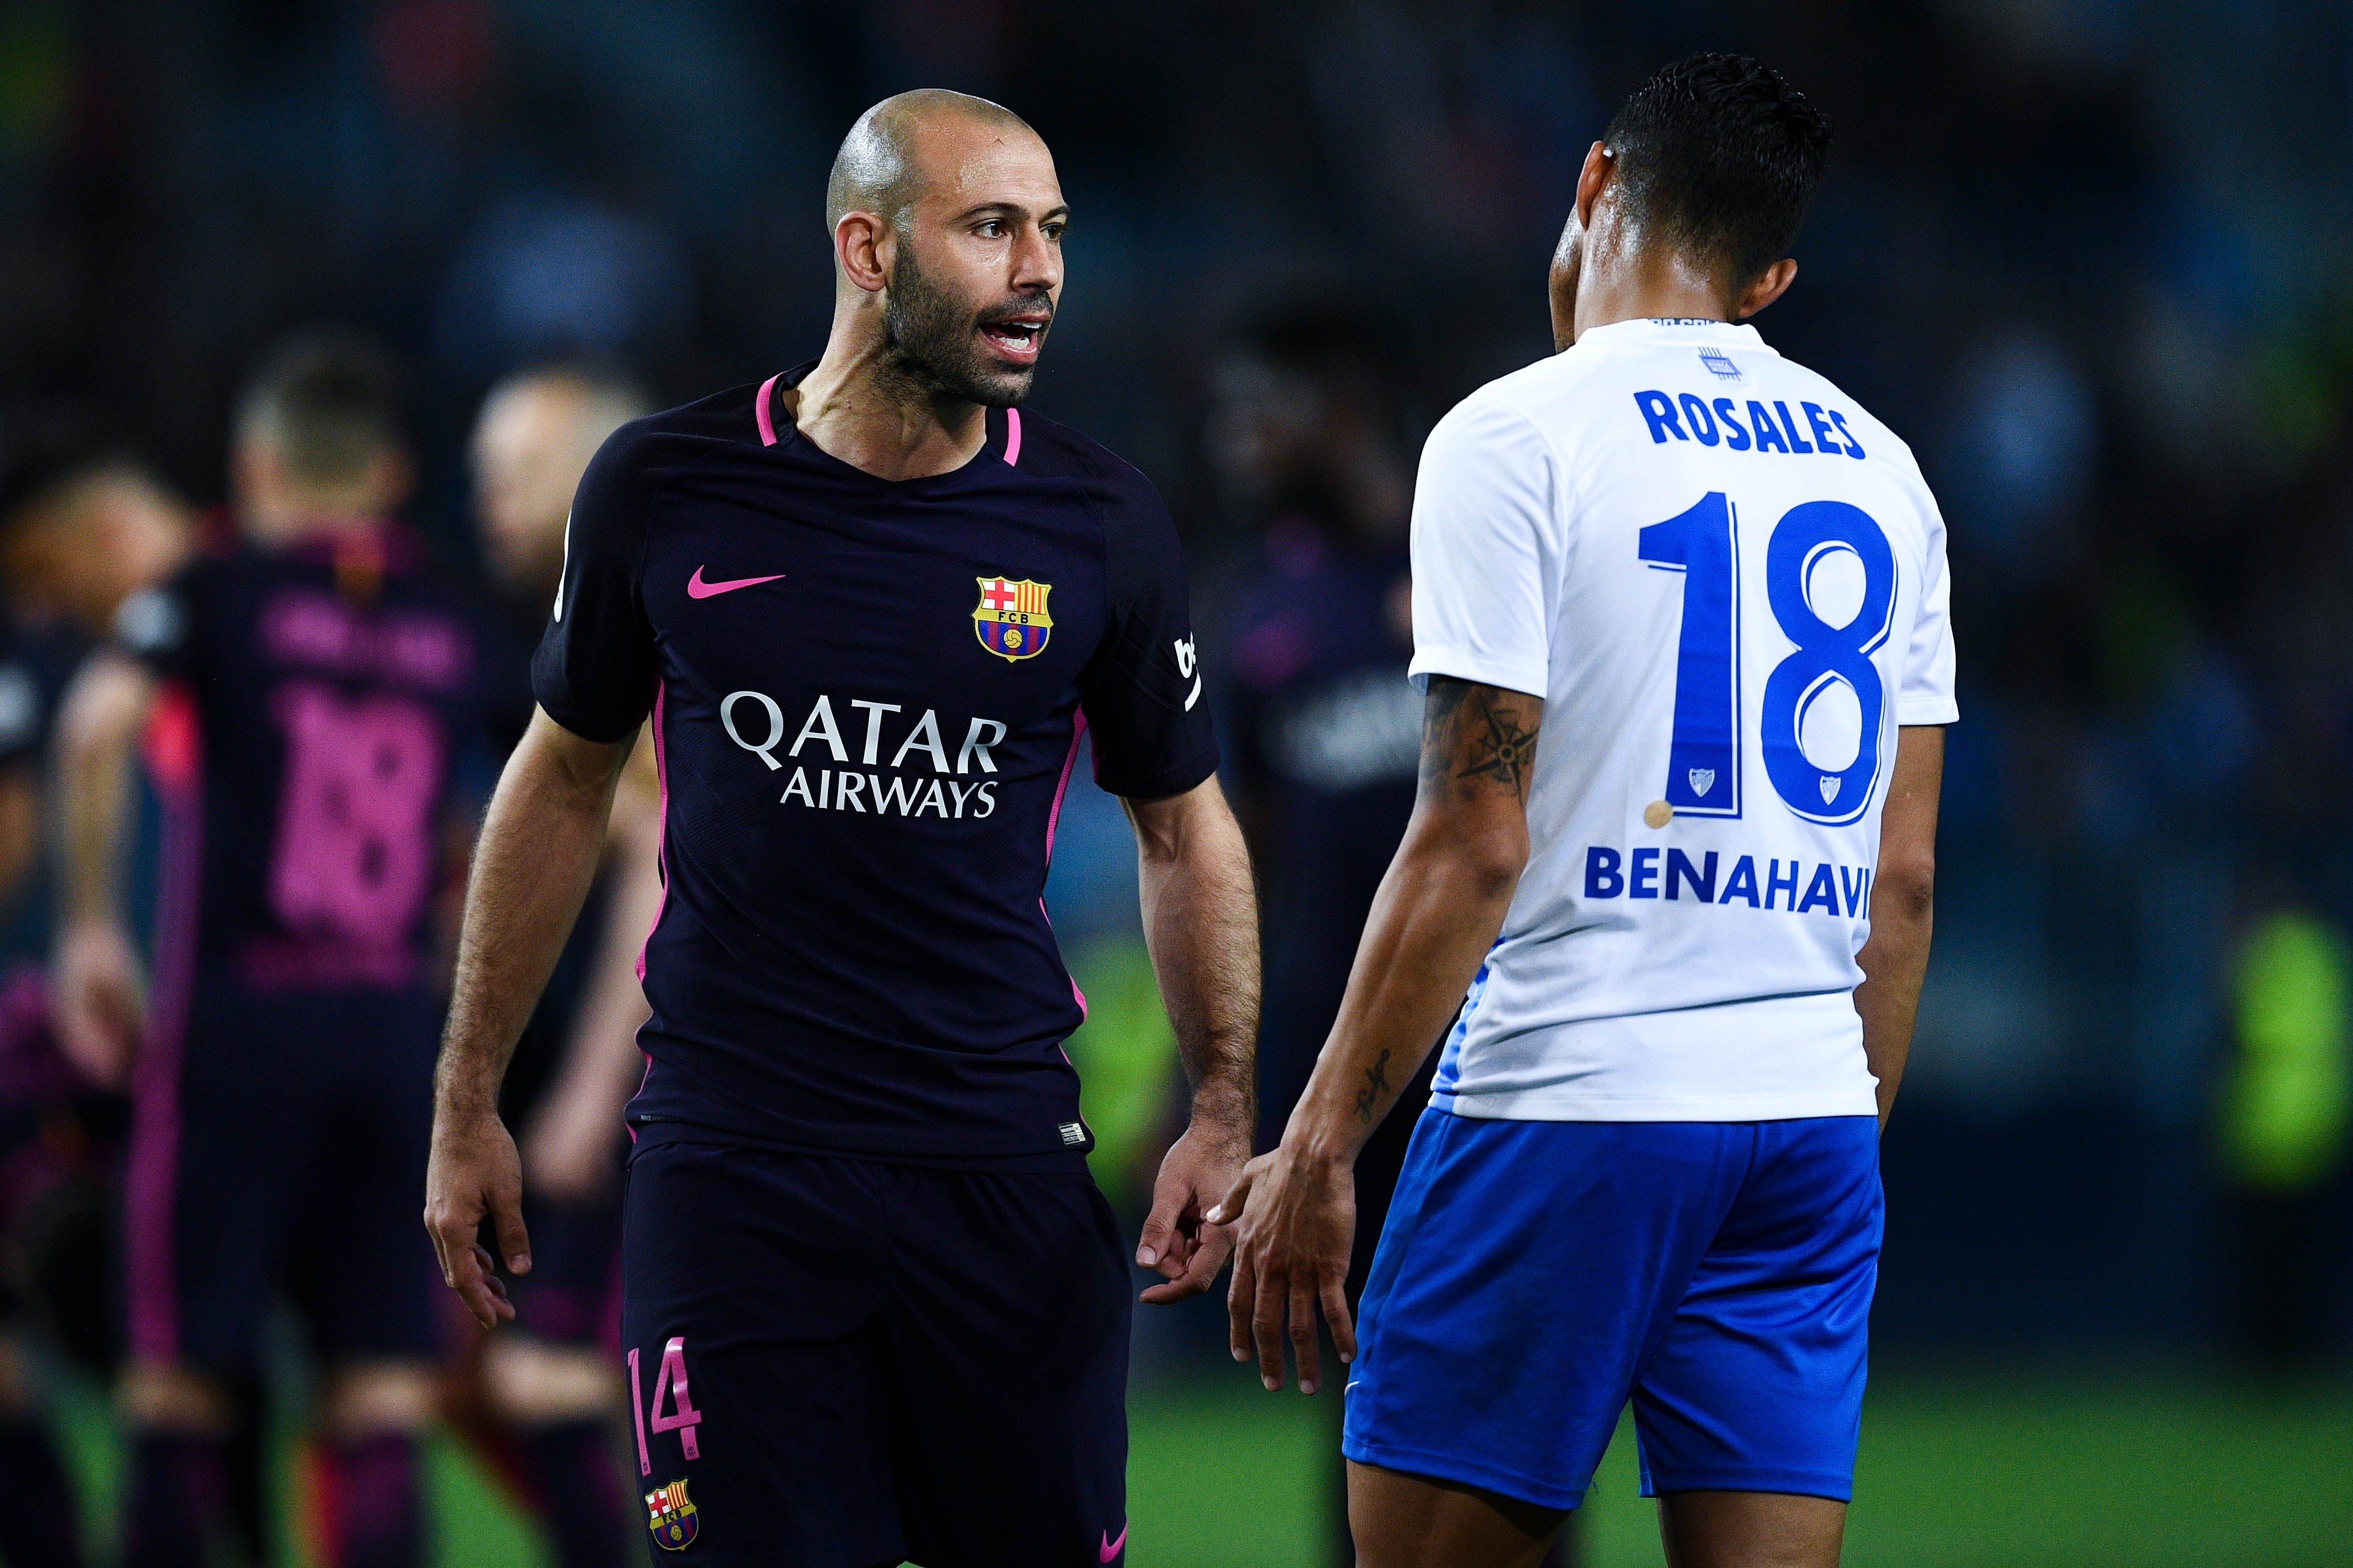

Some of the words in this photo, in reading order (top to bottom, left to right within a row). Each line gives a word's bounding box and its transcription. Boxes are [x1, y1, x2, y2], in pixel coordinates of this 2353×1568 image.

[1633, 390, 1866, 460] ROSALES
[998, 611, 1029, 624] FCB
[1638, 490, 1899, 828] 18
[720, 690, 1007, 775] QATAR
[780, 765, 998, 819] AIRWAYS
[1584, 845, 1870, 921] BENAHAVI
[627, 1336, 702, 1477] 14
[662, 1509, 682, 1524] FCB
